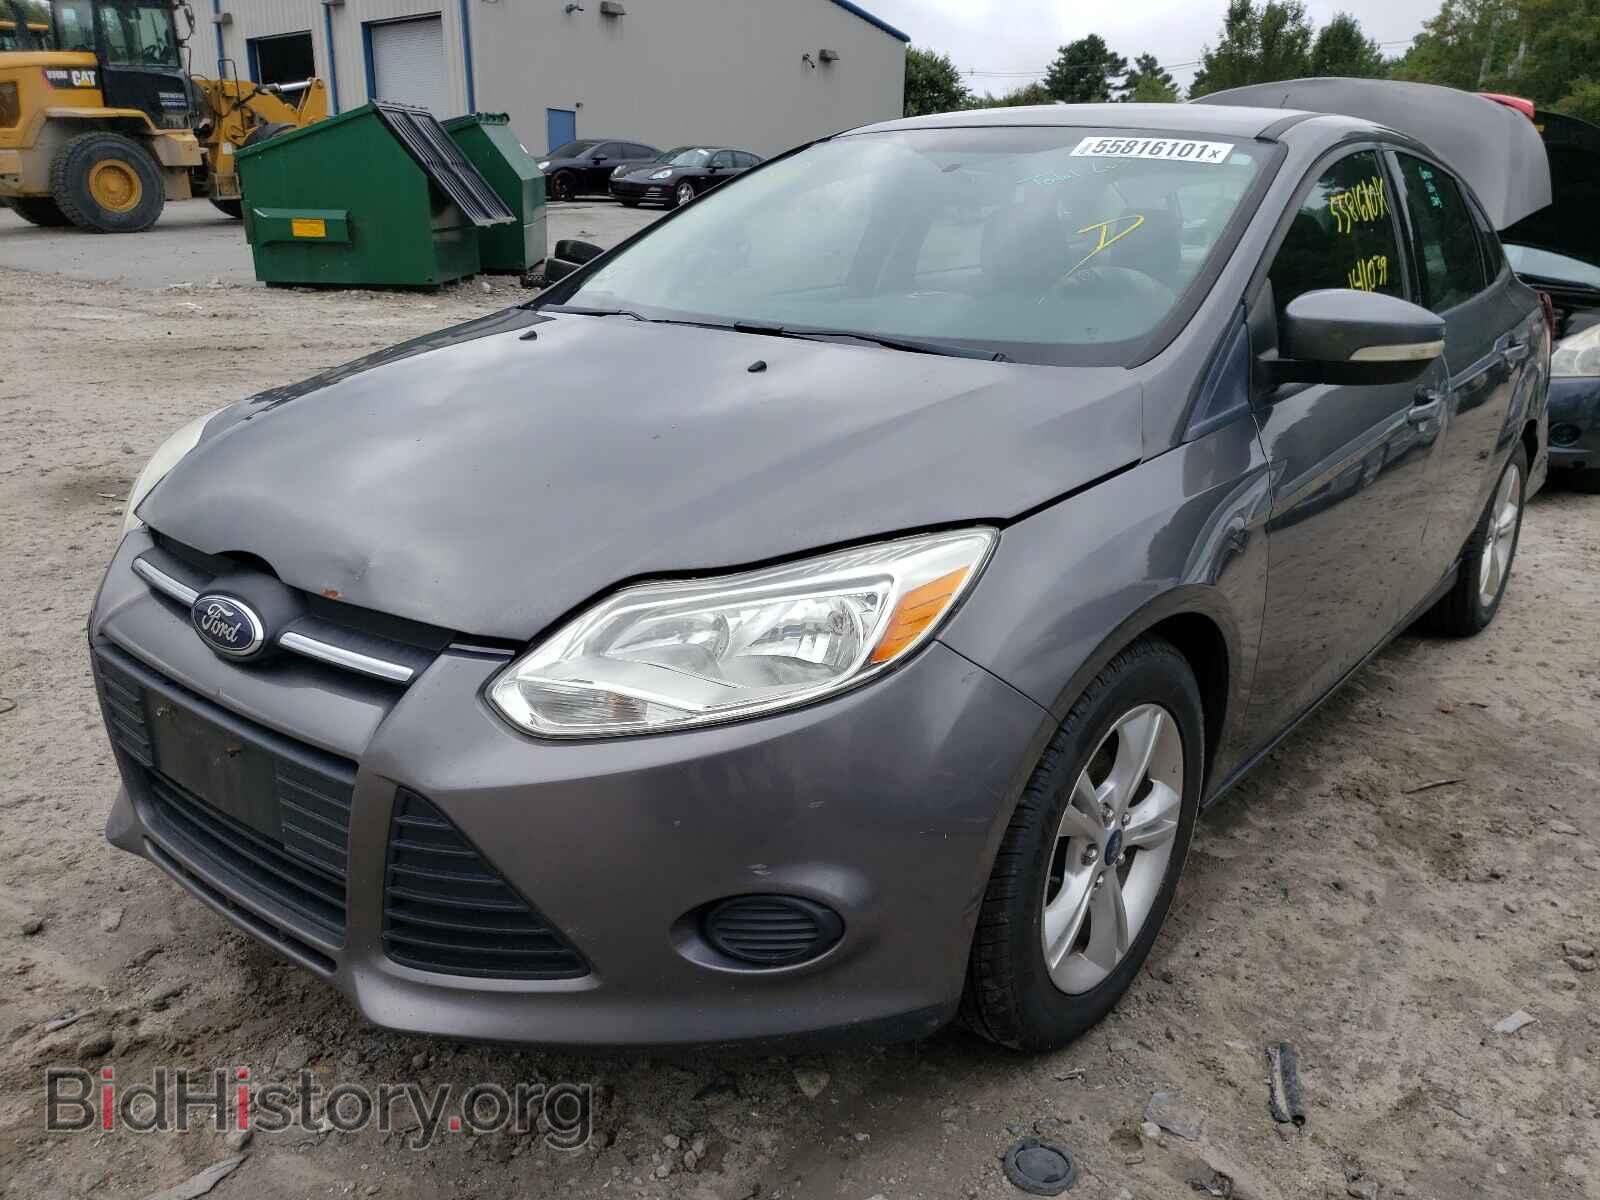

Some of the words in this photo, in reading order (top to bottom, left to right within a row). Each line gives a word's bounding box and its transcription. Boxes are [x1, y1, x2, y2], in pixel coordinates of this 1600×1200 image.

[71, 70, 96, 87] CAT
[1093, 139, 1209, 159] 55816101
[201, 603, 243, 643] Ford
